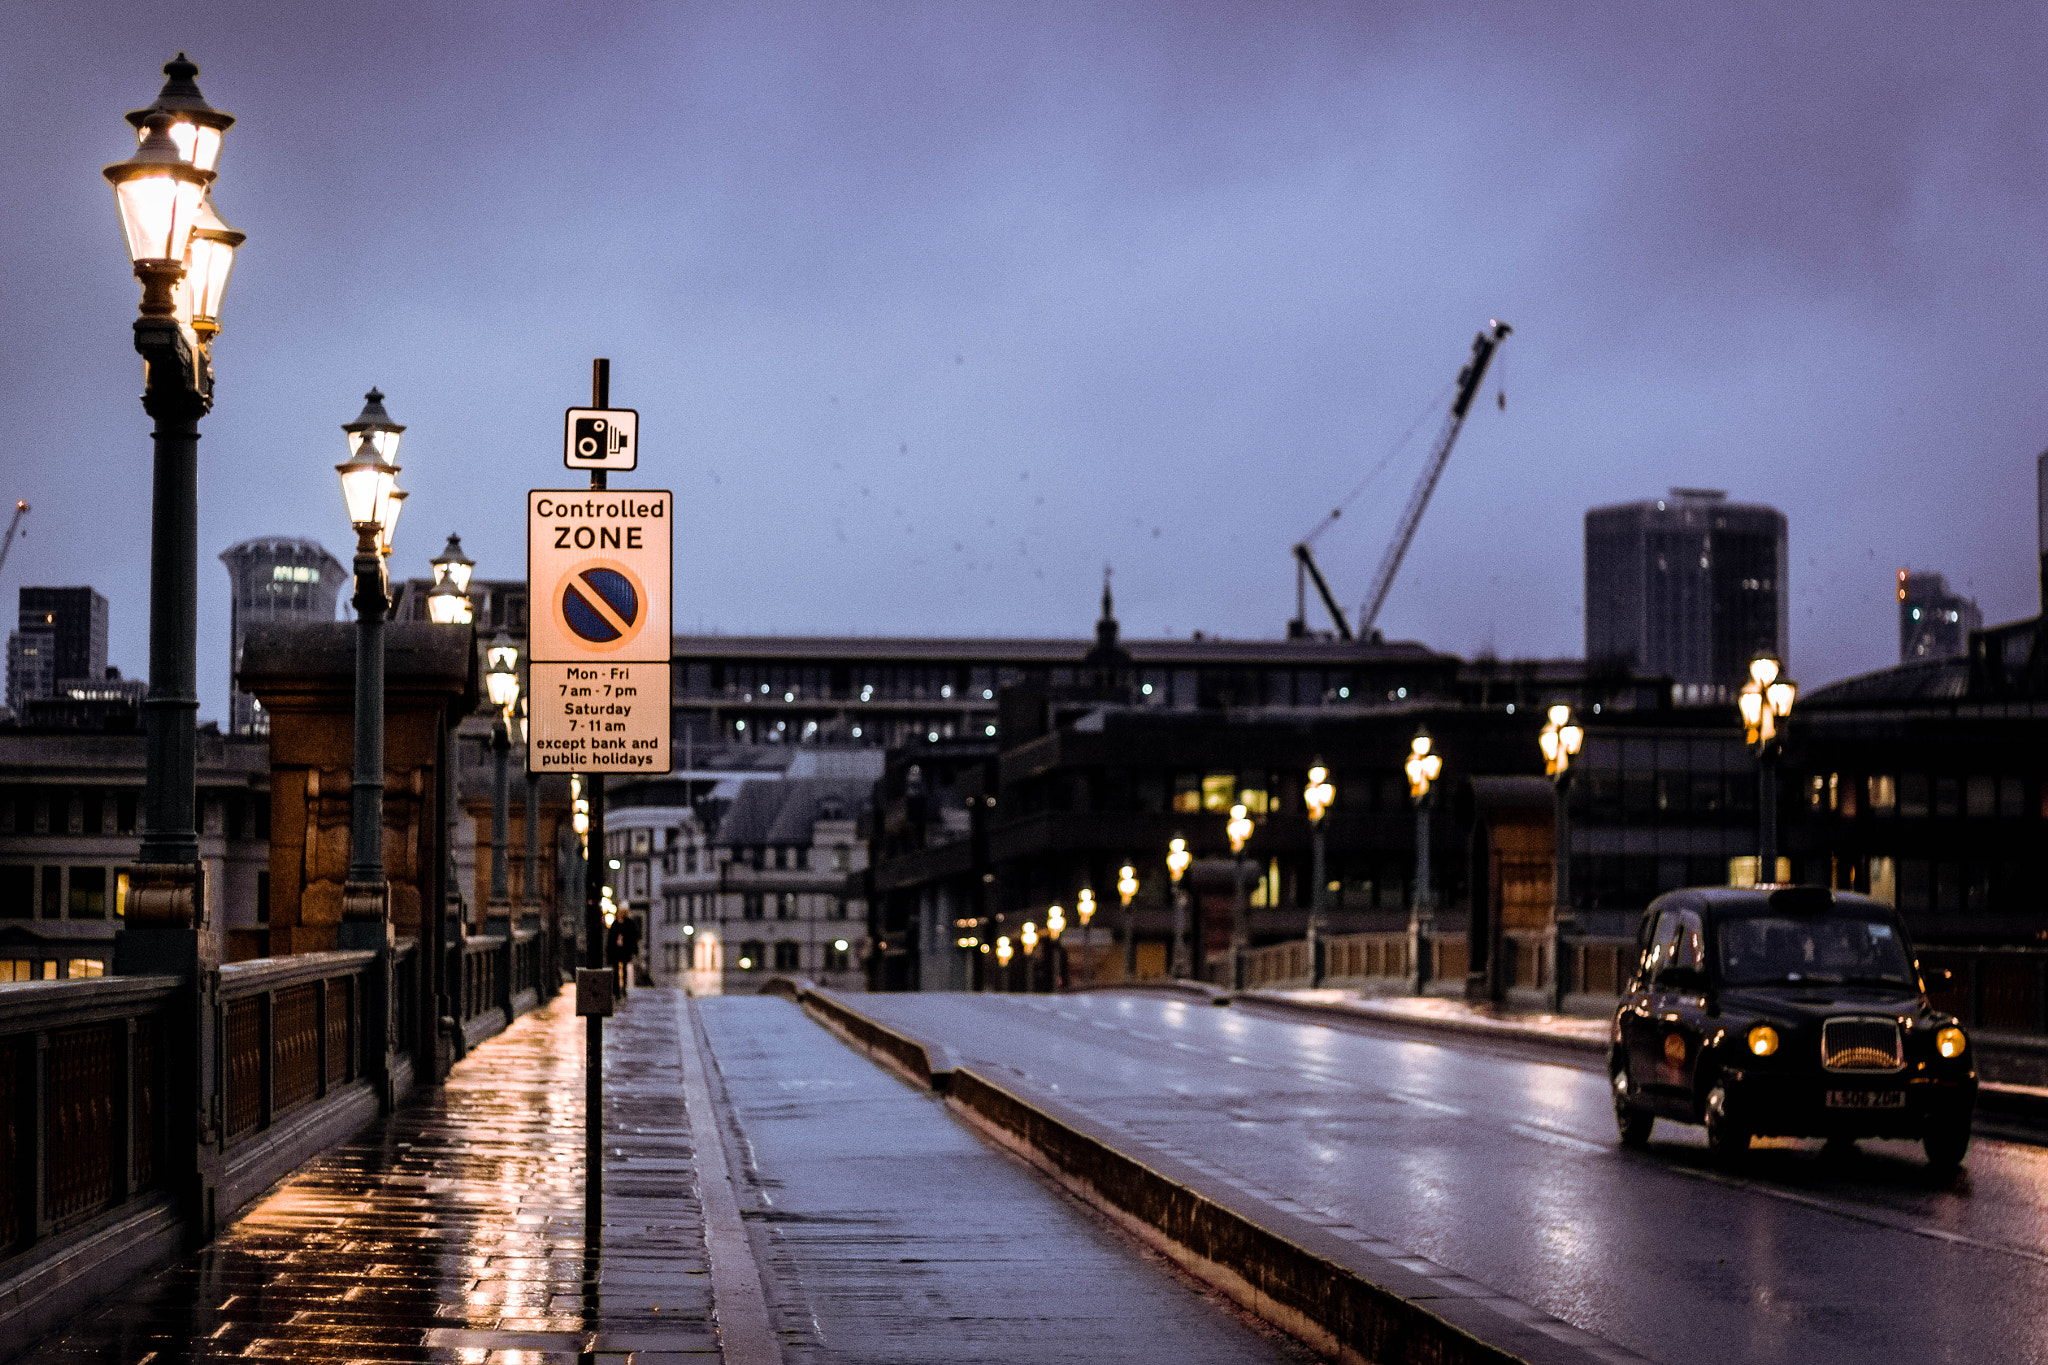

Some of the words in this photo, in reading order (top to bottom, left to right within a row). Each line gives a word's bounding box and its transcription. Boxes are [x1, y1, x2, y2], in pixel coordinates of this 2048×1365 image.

[537, 499, 664, 518] Controlled
[554, 526, 643, 549] ZONE
[567, 668, 598, 680] Mon
[611, 668, 629, 679] Fri
[564, 703, 631, 717] Saturday
[536, 738, 586, 751] except
[591, 737, 626, 749] bank
[632, 737, 658, 749] and
[542, 752, 587, 766] public
[592, 752, 653, 767] holidays
